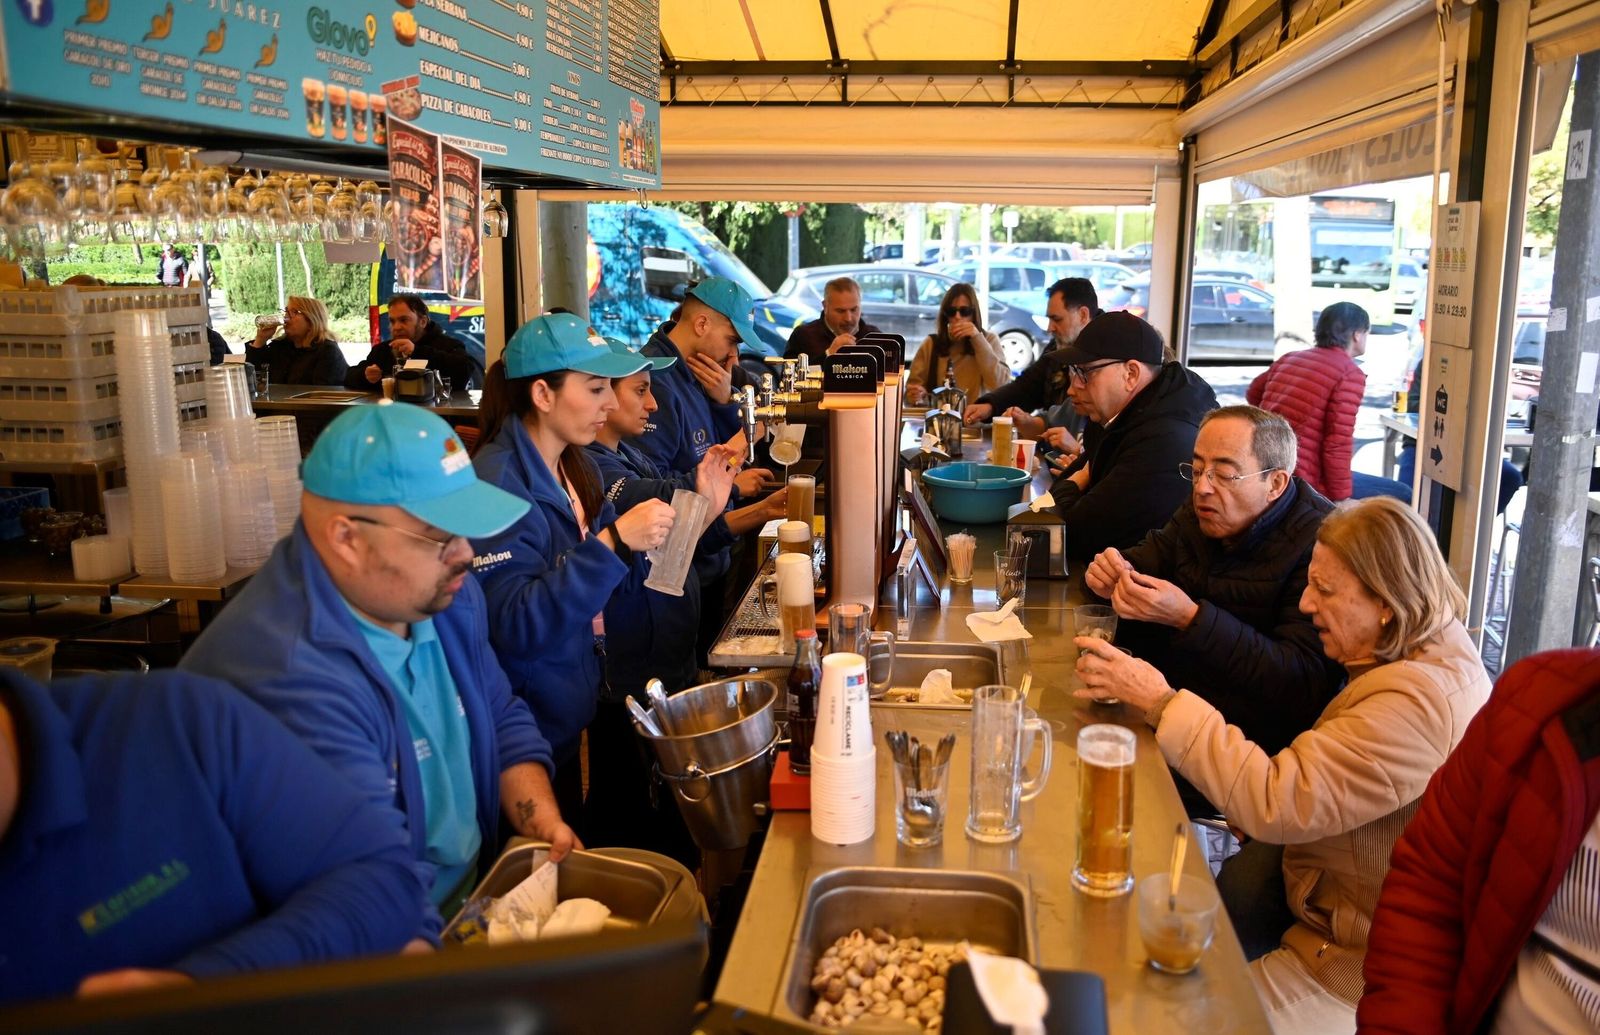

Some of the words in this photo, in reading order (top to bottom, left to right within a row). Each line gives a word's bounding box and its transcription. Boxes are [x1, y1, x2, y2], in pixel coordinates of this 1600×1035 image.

[307, 6, 370, 57] Glovo
[418, 25, 459, 54] MEJICANOS
[420, 59, 455, 84] ESPECIAL
[455, 71, 469, 87] DEL
[469, 75, 481, 90] DIA
[421, 92, 443, 112] PIZZA
[443, 99, 454, 115] DE
[455, 102, 492, 124] CARACOLES
[391, 160, 433, 191] CARACOLES
[1438, 283, 1459, 297] HORARIO
[832, 363, 868, 374] Mahou
[472, 550, 513, 568] Mahou
